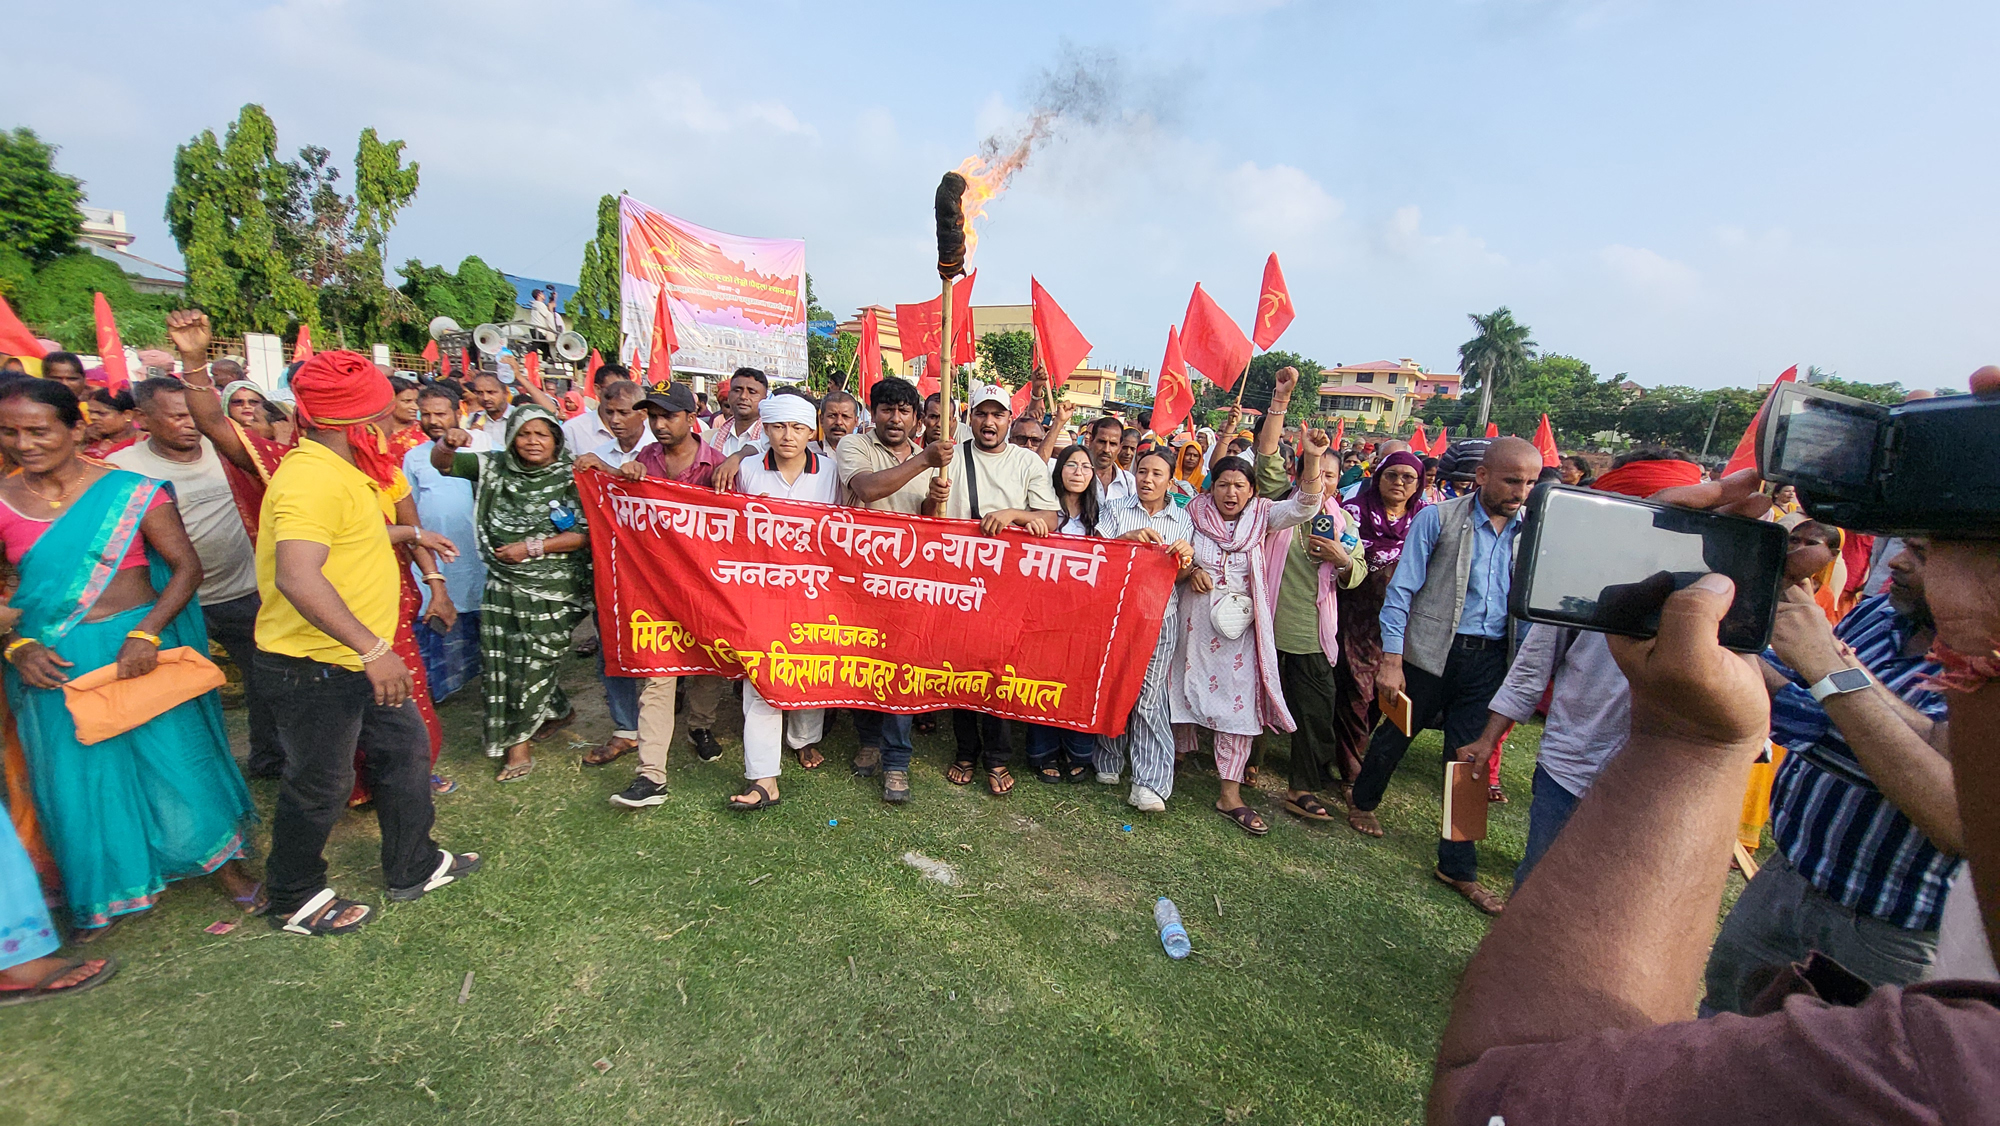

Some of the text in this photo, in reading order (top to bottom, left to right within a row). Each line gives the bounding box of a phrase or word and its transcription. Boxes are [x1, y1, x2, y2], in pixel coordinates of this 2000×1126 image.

[742, 502, 817, 553] विरुद्ध
[818, 511, 918, 569] (पैदल)
[922, 533, 1012, 576] न्याय
[1018, 544, 1108, 588] मार्च
[710, 559, 834, 600] जनकपुर
[862, 572, 988, 612] काठमाण्डौ
[766, 640, 839, 694] किसान
[839, 655, 899, 702] मजदुर
[995, 664, 1068, 712] नेपाल
